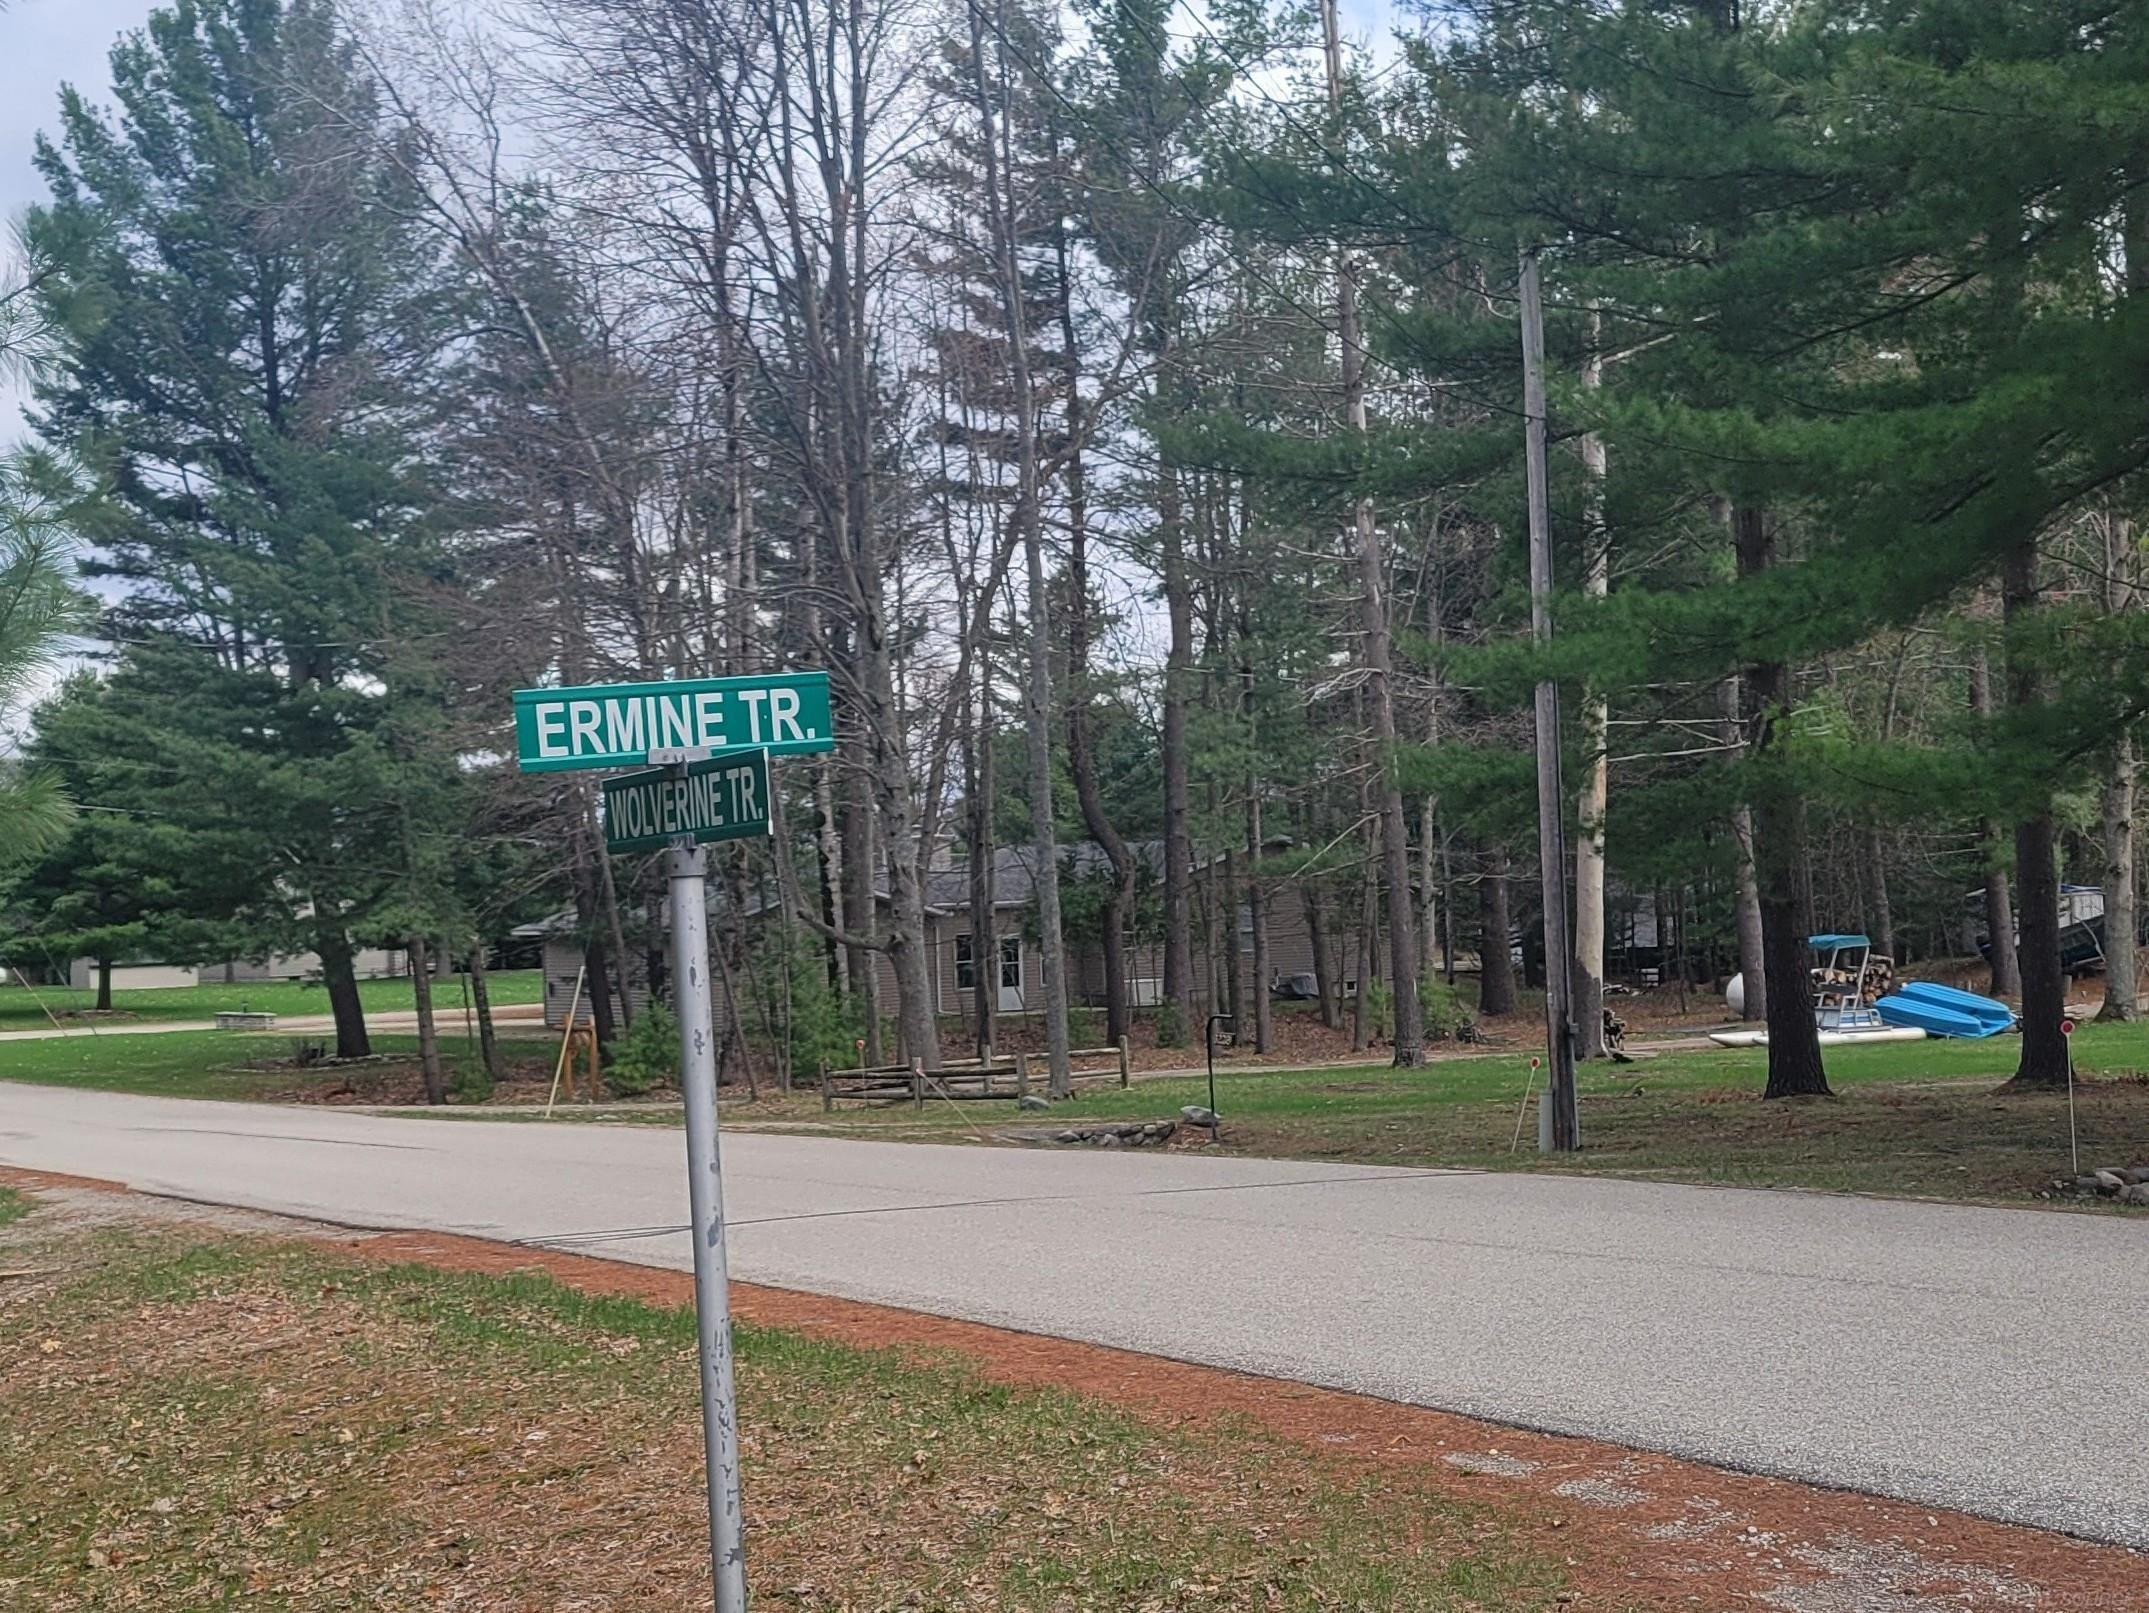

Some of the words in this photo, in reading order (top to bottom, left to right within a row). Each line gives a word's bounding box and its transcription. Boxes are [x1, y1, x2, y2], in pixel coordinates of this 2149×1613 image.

[536, 692, 727, 758] ERMINE
[738, 688, 816, 742] TR.
[609, 771, 724, 840] WOLVERINE
[726, 766, 764, 824] TR.
